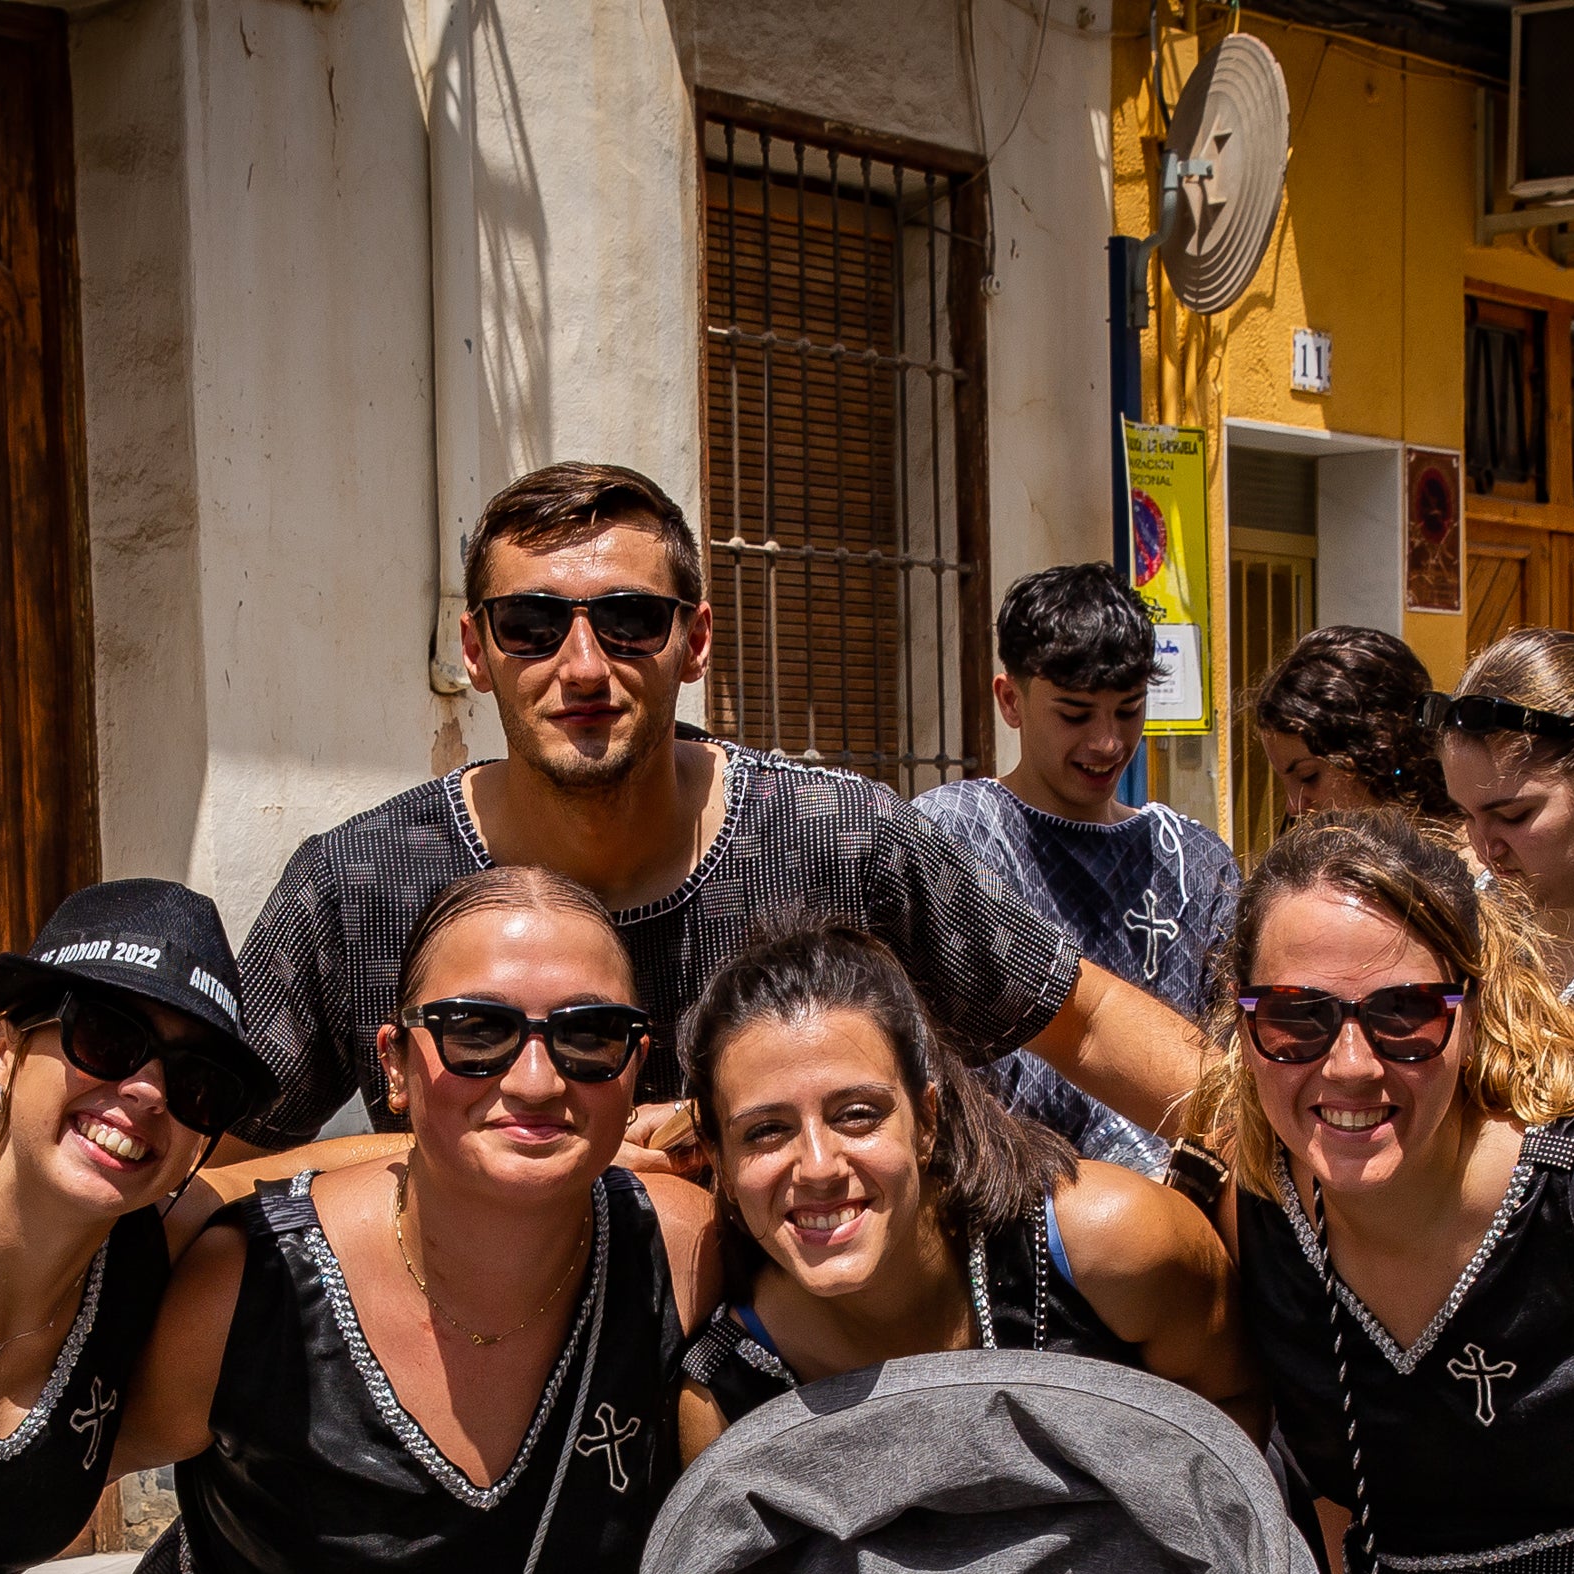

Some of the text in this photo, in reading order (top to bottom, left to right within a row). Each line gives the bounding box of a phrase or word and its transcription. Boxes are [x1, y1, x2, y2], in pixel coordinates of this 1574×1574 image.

[1301, 344, 1323, 379] 11
[53, 940, 112, 966] HONOR
[112, 942, 161, 969] 2022
[189, 966, 239, 1022] ANTONIA
